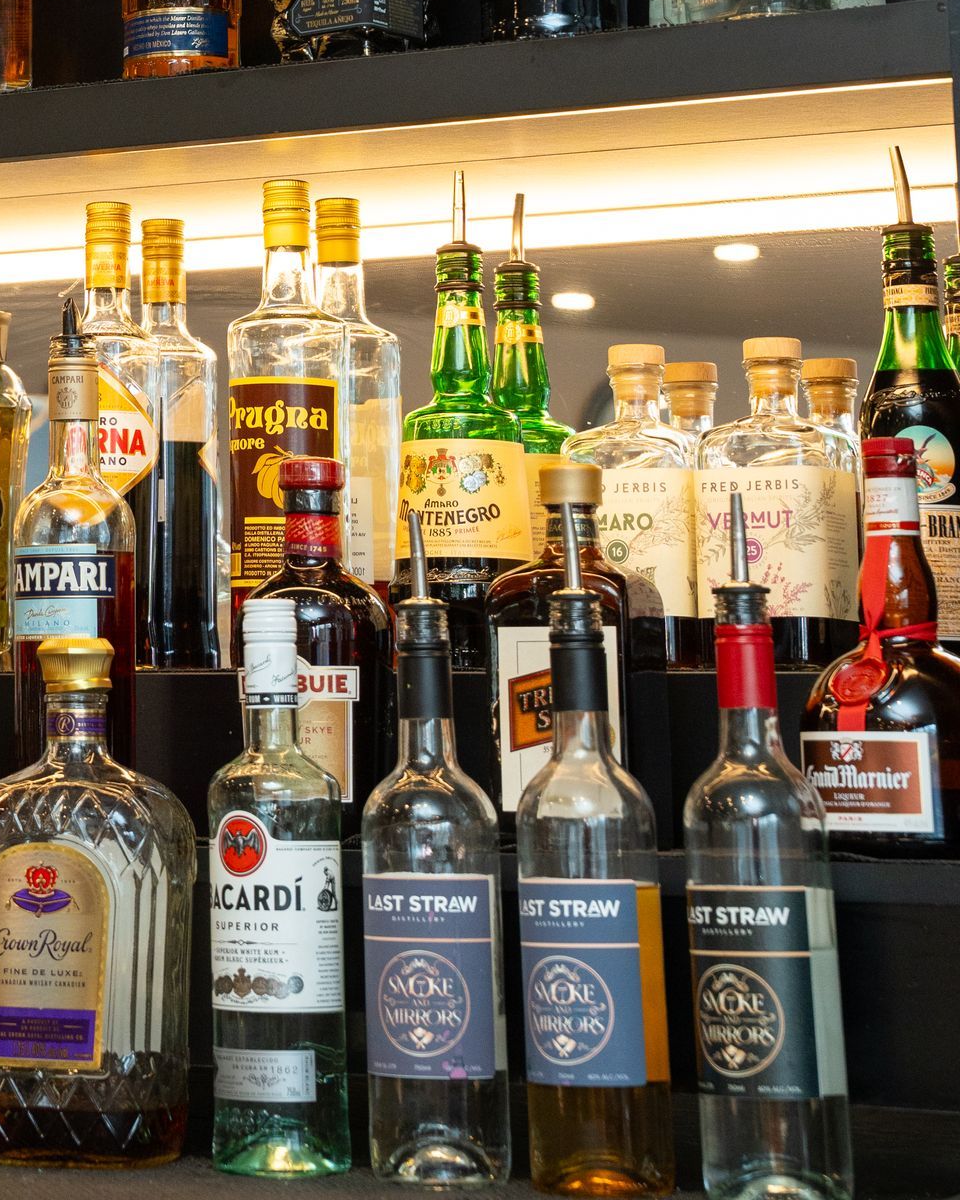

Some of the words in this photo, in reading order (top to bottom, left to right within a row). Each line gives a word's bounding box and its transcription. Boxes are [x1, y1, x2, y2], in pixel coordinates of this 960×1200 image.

[306, 18, 333, 29] TEQUILA
[334, 15, 354, 26] AÑEJO
[52, 375, 84, 385] CAMPARI
[99, 428, 146, 456] RNA
[614, 482, 667, 493] JERBIS
[702, 482, 739, 493] FRED
[746, 479, 800, 492] JERBIS
[424, 499, 459, 509] AMARO
[599, 513, 654, 532] MARO
[429, 528, 452, 537] 1885
[611, 546, 623, 557] 16
[14, 561, 108, 592] AMPARI
[297, 674, 348, 694] BUIE
[274, 694, 294, 703] WHITE
[305, 726, 333, 734] SKYE
[368, 894, 404, 911] LAST
[409, 895, 478, 913] STRAW
[549, 899, 621, 918] STRAW
[535, 920, 585, 928] DISTILLERY
[687, 906, 713, 924] AST
[716, 906, 790, 926] STRAW
[216, 921, 280, 932] SUPERIOR
[28, 928, 93, 961] Royal
[3, 967, 28, 976] FINE
[32, 968, 47, 976] DE
[50, 968, 77, 977] LUXE
[388, 974, 454, 998] SMOKE
[534, 980, 595, 1004] SMOKE
[702, 988, 765, 1015] SMOKE
[384, 1005, 462, 1028] MIRRORS
[531, 1013, 606, 1036] MIRRORS
[702, 1025, 777, 1048] MIRRORS
[271, 1066, 299, 1074] 1862
